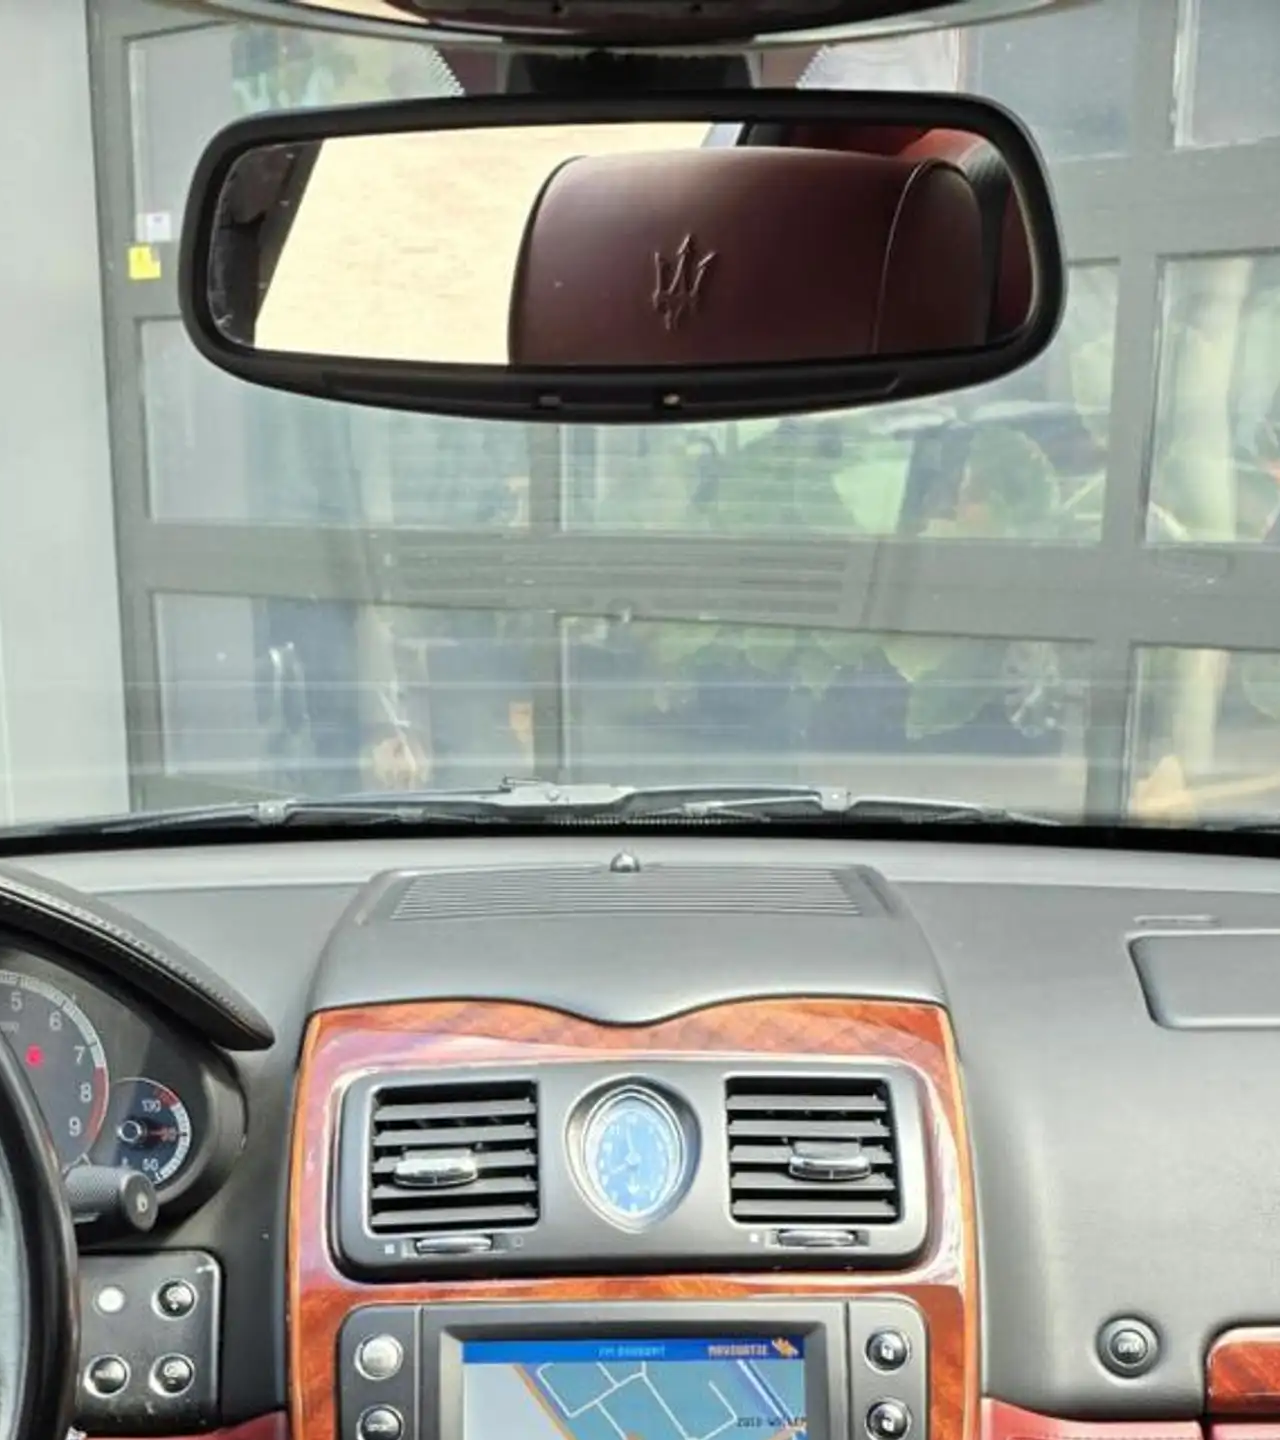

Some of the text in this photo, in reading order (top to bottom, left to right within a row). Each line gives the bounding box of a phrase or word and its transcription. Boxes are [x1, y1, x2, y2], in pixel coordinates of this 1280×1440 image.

[10, 992, 23, 1011] 5
[49, 1011, 62, 1031] 6
[74, 1046, 86, 1064] 7
[80, 1082, 93, 1102] 8
[141, 1100, 163, 1113] 130
[69, 1116, 82, 1137] 9
